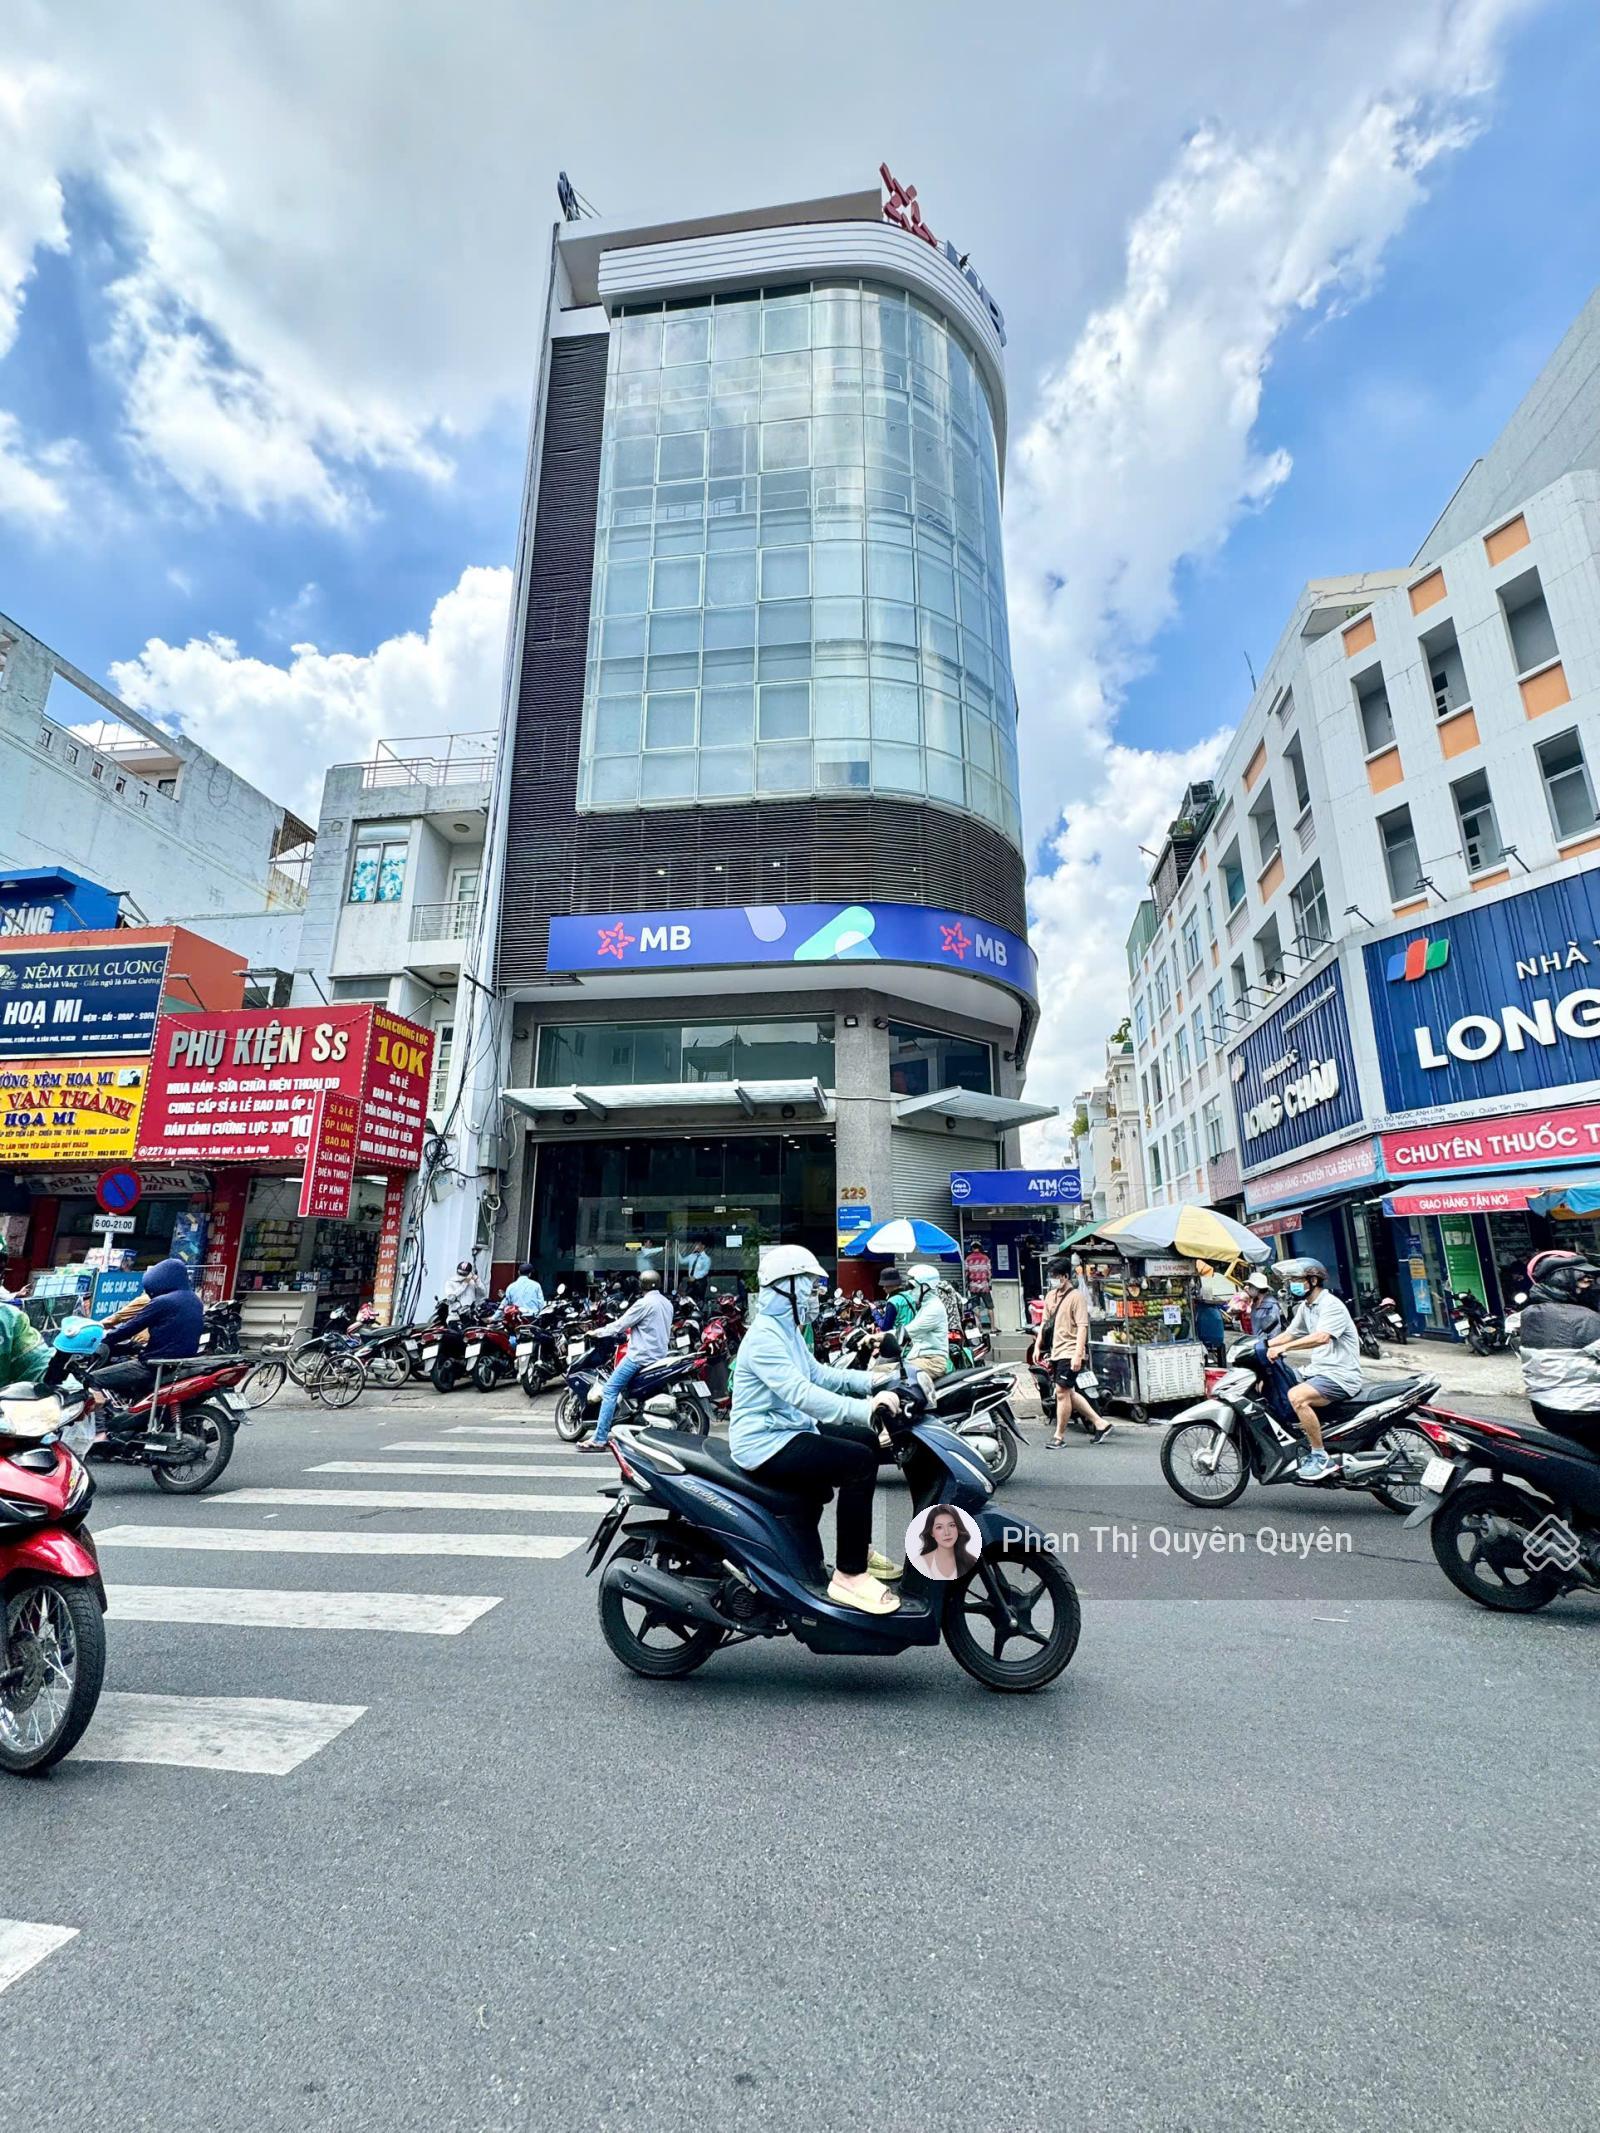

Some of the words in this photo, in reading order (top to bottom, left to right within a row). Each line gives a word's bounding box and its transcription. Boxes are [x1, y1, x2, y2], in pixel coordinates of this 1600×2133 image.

[640, 925, 692, 952] MB
[976, 933, 1008, 966] MB
[1516, 938, 1590, 980] NHÀ
[23, 962, 63, 982] NỆM
[66, 964, 100, 978] KIM
[104, 960, 164, 976] CƯƠNG
[3, 1000, 46, 1029] HOẠ
[52, 999, 82, 1023] MI
[1414, 988, 1600, 1070] LONG
[168, 1030, 225, 1074] PHỤ
[232, 1020, 304, 1071] KIỆN
[376, 1036, 428, 1078] 10K
[33, 1070, 62, 1088] NỆM
[98, 1072, 115, 1086] MI
[166, 1082, 190, 1094] MUA
[7, 1090, 53, 1110] VẠN
[60, 1088, 136, 1121] THÀNH
[168, 1102, 195, 1114] CUNG
[196, 1098, 217, 1114] CẤP
[229, 1101, 238, 1113] &
[253, 1099, 274, 1112] BAO
[275, 1099, 289, 1111] DA
[1243, 1094, 1283, 1140] LONG
[1284, 1058, 1339, 1118] CHÂU
[52, 1112, 76, 1126] MI
[338, 1105, 344, 1116] &
[164, 1121, 186, 1136] DÁN
[186, 1121, 212, 1136] KÍNH
[212, 1120, 247, 1135] CƯỜNG
[248, 1121, 269, 1136] LỰC
[325, 1135, 339, 1146] BAO
[1395, 1136, 1484, 1165] CHUYÊN
[1487, 1121, 1579, 1154] THUỐC
[147, 1146, 163, 1155] 227
[841, 1187, 867, 1200] 229
[1028, 1179, 1057, 1190] ATM
[1420, 1200, 1441, 1209] GIAO
[1443, 1196, 1469, 1208] HÀNG
[1470, 1194, 1490, 1209] TẬN
[1490, 1194, 1509, 1205] NƠI
[127, 1281, 139, 1295] SẠC
[95, 1301, 109, 1317] SẠC
[680, 1479, 718, 1505] Candy
